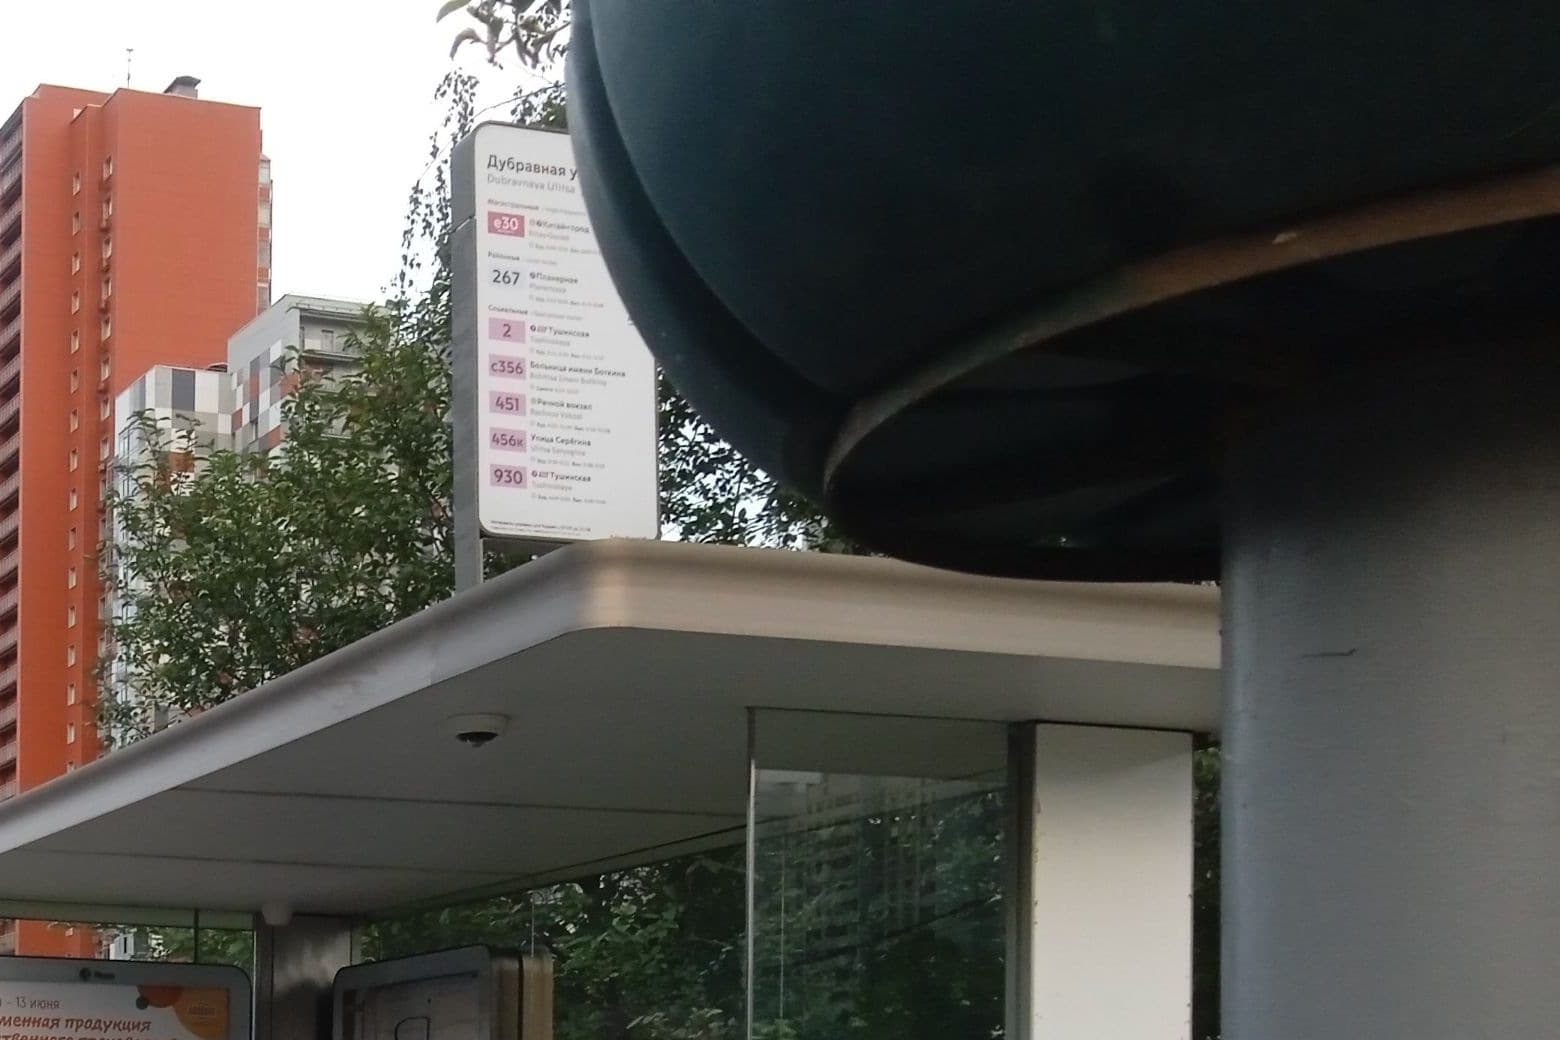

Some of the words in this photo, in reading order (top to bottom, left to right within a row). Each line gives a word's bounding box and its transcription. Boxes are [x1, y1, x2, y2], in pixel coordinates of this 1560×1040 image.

[487, 154, 566, 177] Дубравная
[492, 269, 520, 285] 267
[502, 323, 512, 338] 2
[495, 396, 519, 411] 451
[494, 468, 523, 485] 930
[16, 996, 27, 1008] 13
[29, 999, 60, 1009] июня
[64, 1017, 152, 1033] продукция
